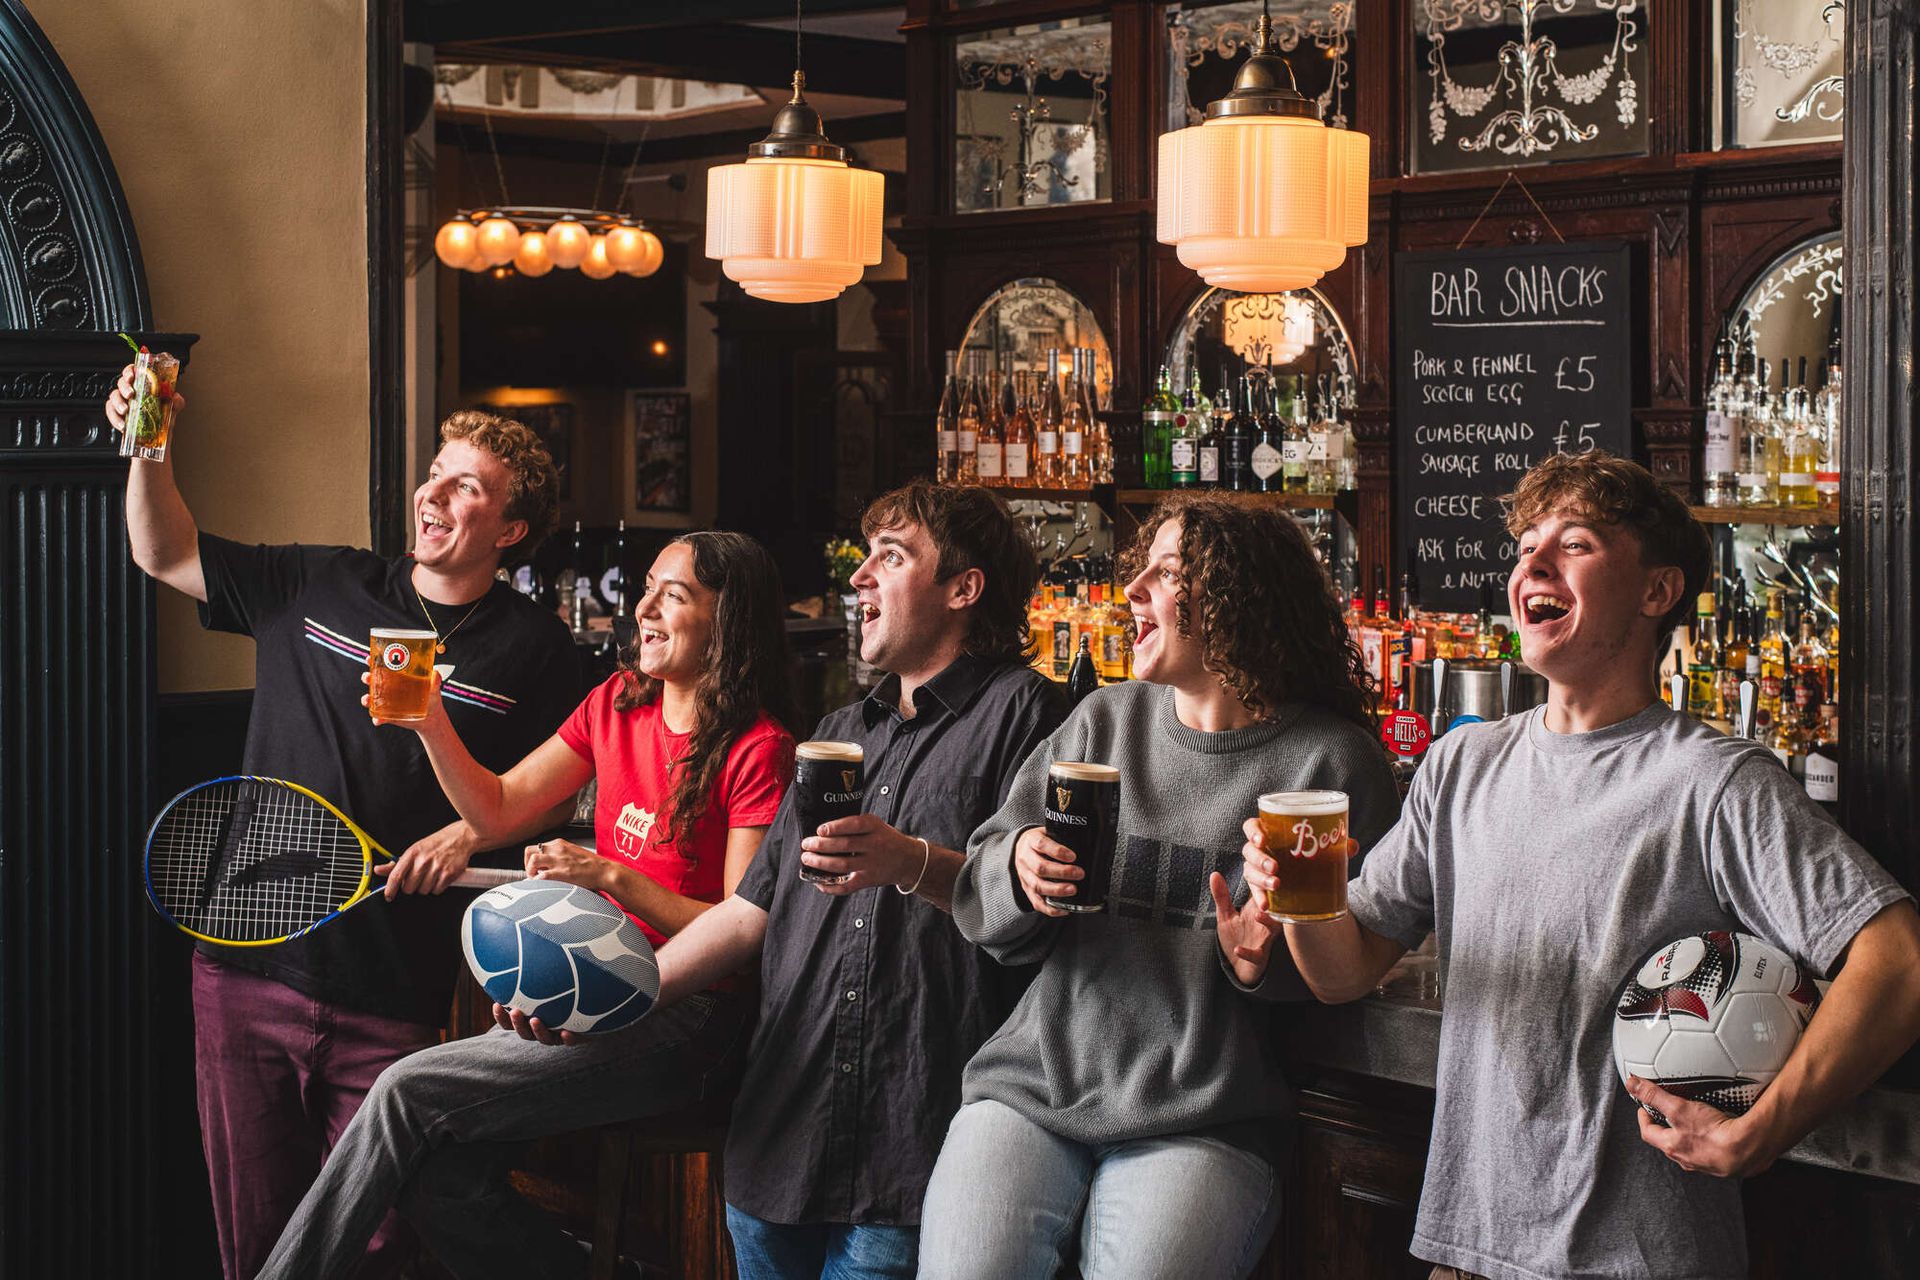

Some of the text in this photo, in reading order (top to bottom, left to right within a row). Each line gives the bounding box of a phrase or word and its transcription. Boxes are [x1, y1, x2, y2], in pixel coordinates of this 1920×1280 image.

[1431, 265, 1607, 317] BAR SNACKS
[1413, 349, 1446, 380] PORK
[1472, 353, 1537, 378] FENNEL
[1555, 356, 1597, 392] £5
[1423, 382, 1524, 405] SCOTCH EGG
[1415, 422, 1534, 445] CUMBERLAND
[1552, 420, 1601, 459] £5
[1419, 452, 1533, 478] SAUSAGE ROLL
[1415, 495, 1482, 520] CHEESE
[1417, 537, 1521, 562] ASK FOR OU
[1460, 571, 1509, 591] NUTS
[1394, 722, 1418, 743] HELLS
[622, 812, 649, 833] NIKE
[621, 831, 634, 850] 71
